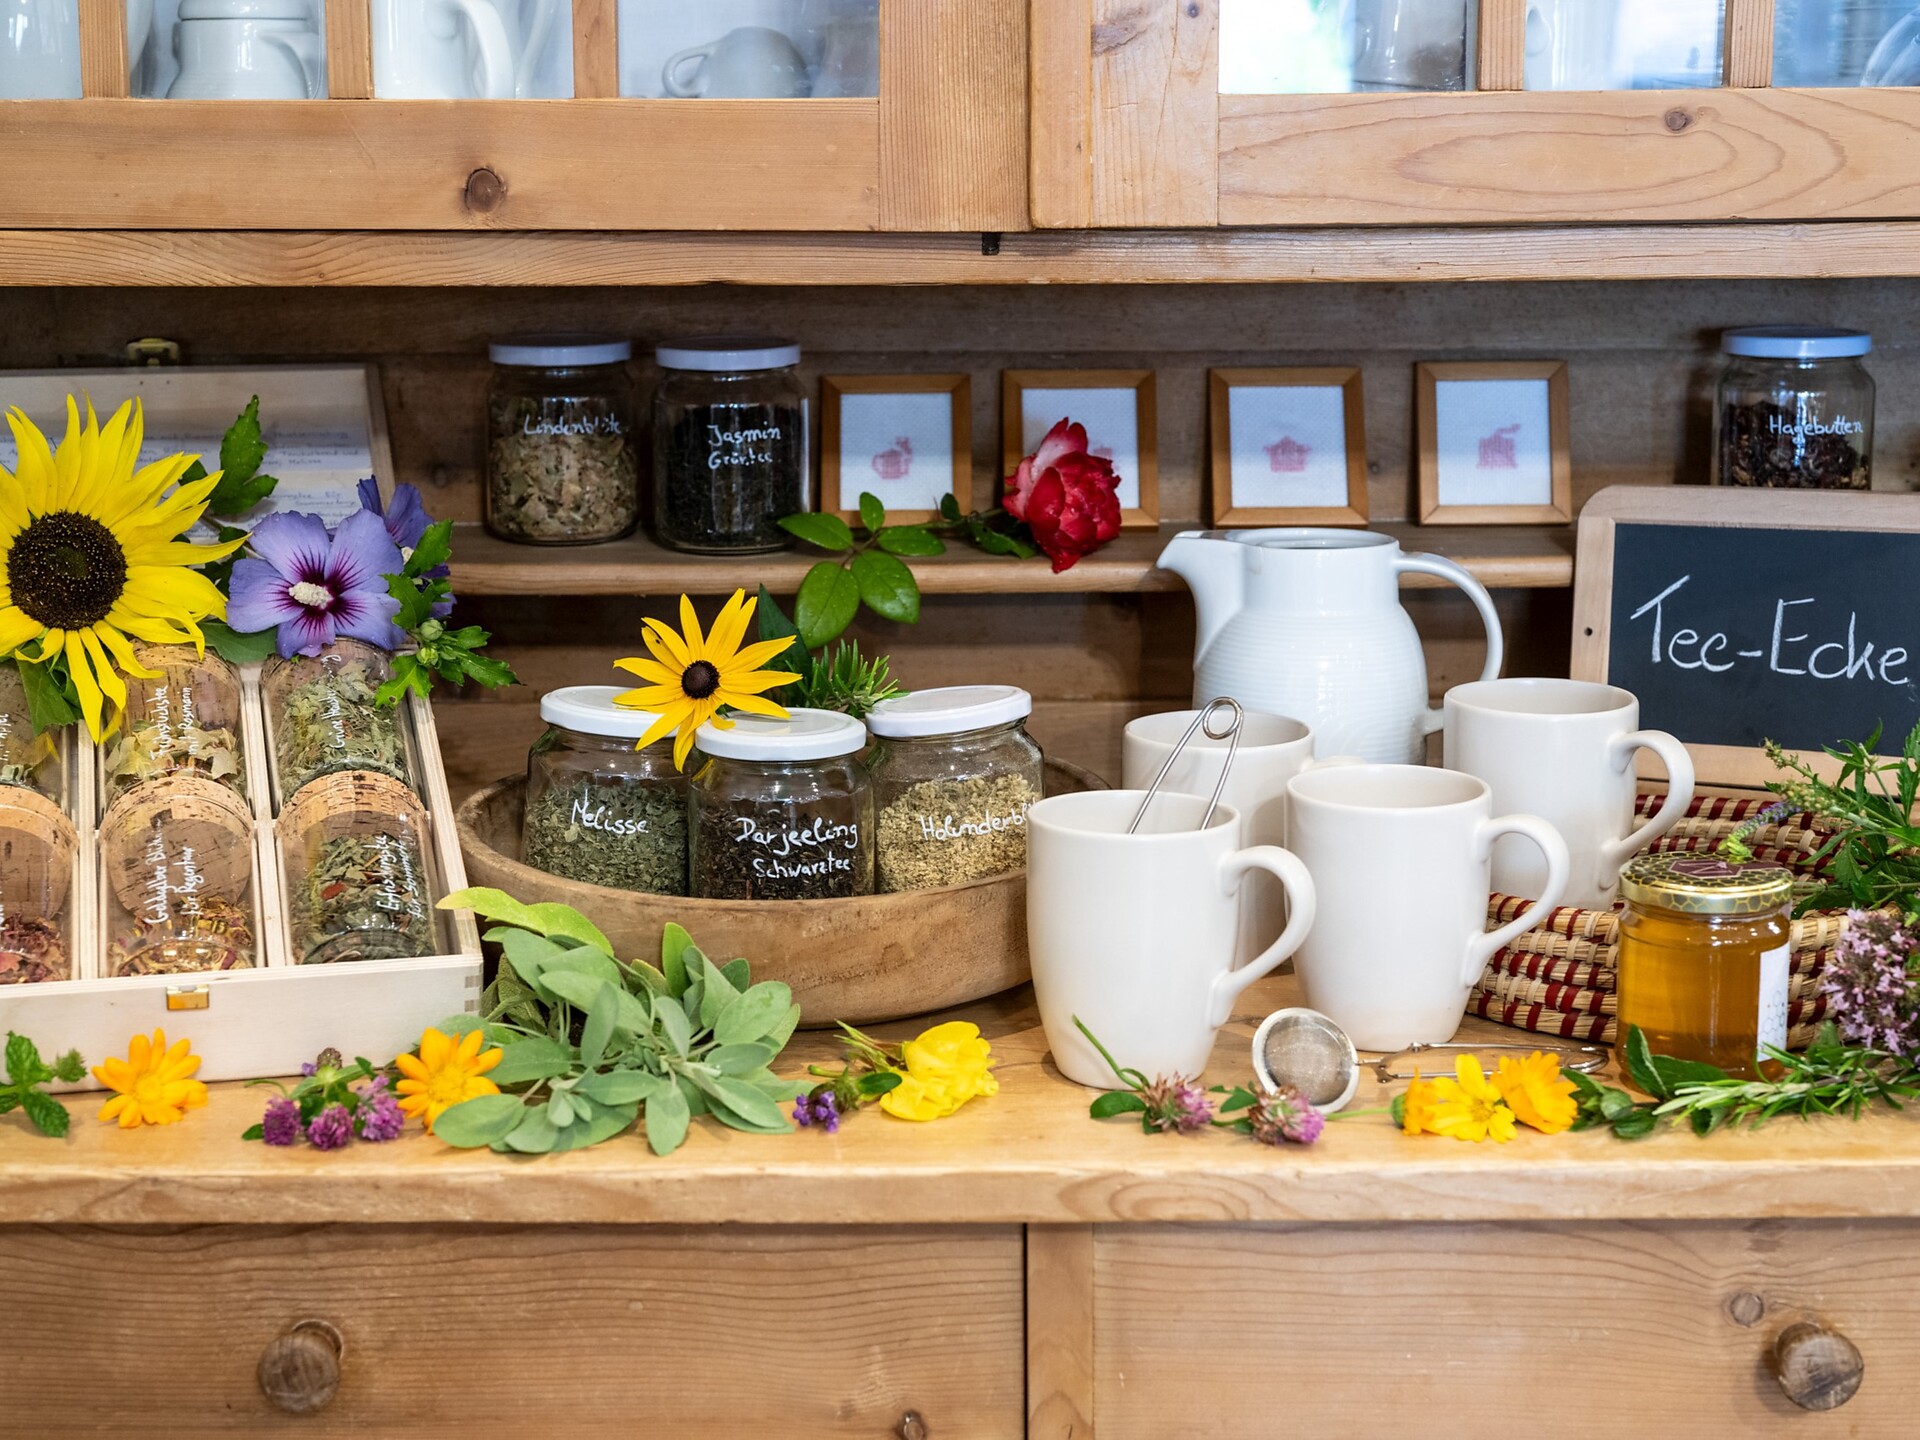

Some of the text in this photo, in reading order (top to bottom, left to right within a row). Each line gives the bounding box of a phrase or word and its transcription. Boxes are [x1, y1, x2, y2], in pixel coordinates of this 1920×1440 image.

[524, 413, 621, 435] Lindenblte
[707, 421, 781, 447] Jasmin
[1769, 414, 1863, 445] Hagebutten
[1630, 574, 1910, 685] Tee-Ecke
[571, 788, 649, 834] Melisse
[920, 797, 1036, 840] Holunderbl
[735, 817, 858, 855] Darjeeling
[752, 851, 851, 879] Schwarztee
